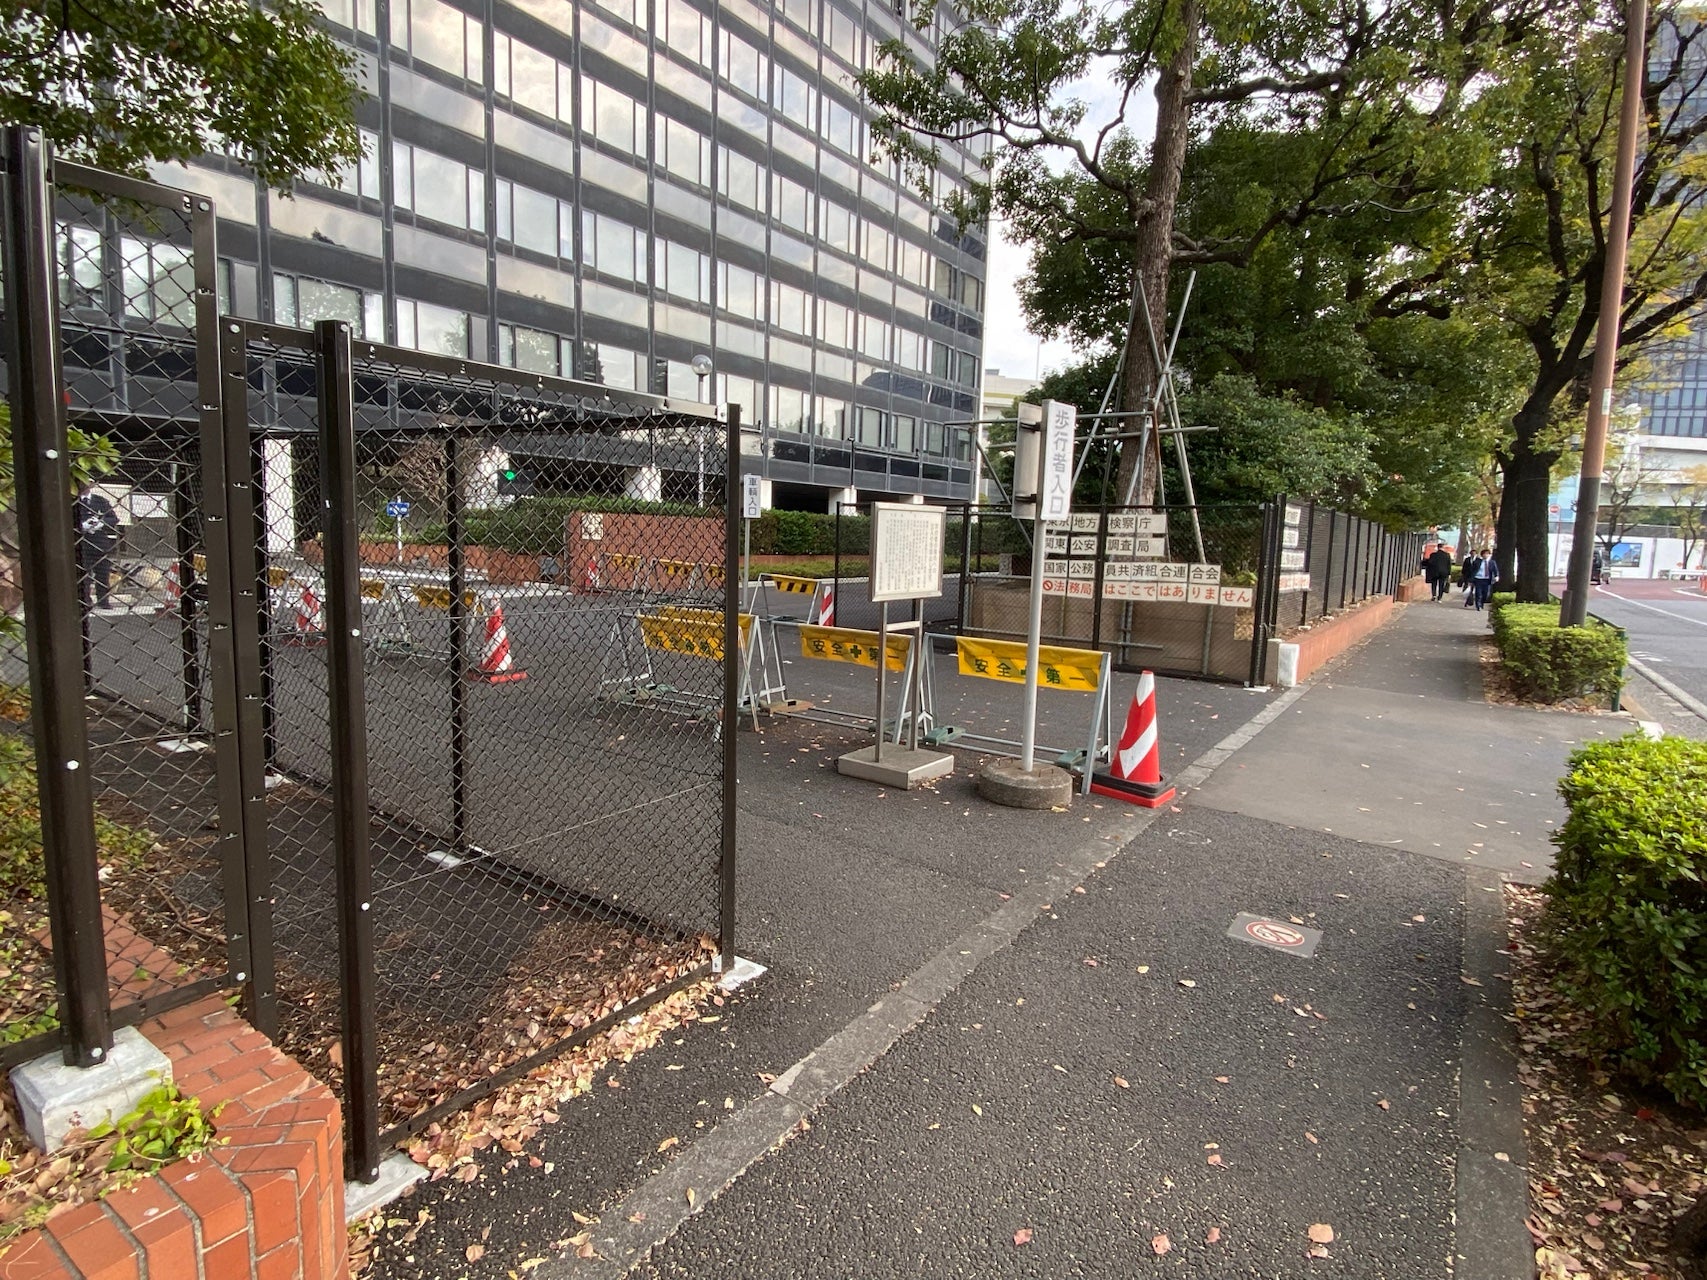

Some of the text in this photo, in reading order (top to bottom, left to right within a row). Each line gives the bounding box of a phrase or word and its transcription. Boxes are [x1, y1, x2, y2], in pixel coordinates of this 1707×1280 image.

[1050, 409, 1069, 514] 歩行者入口
